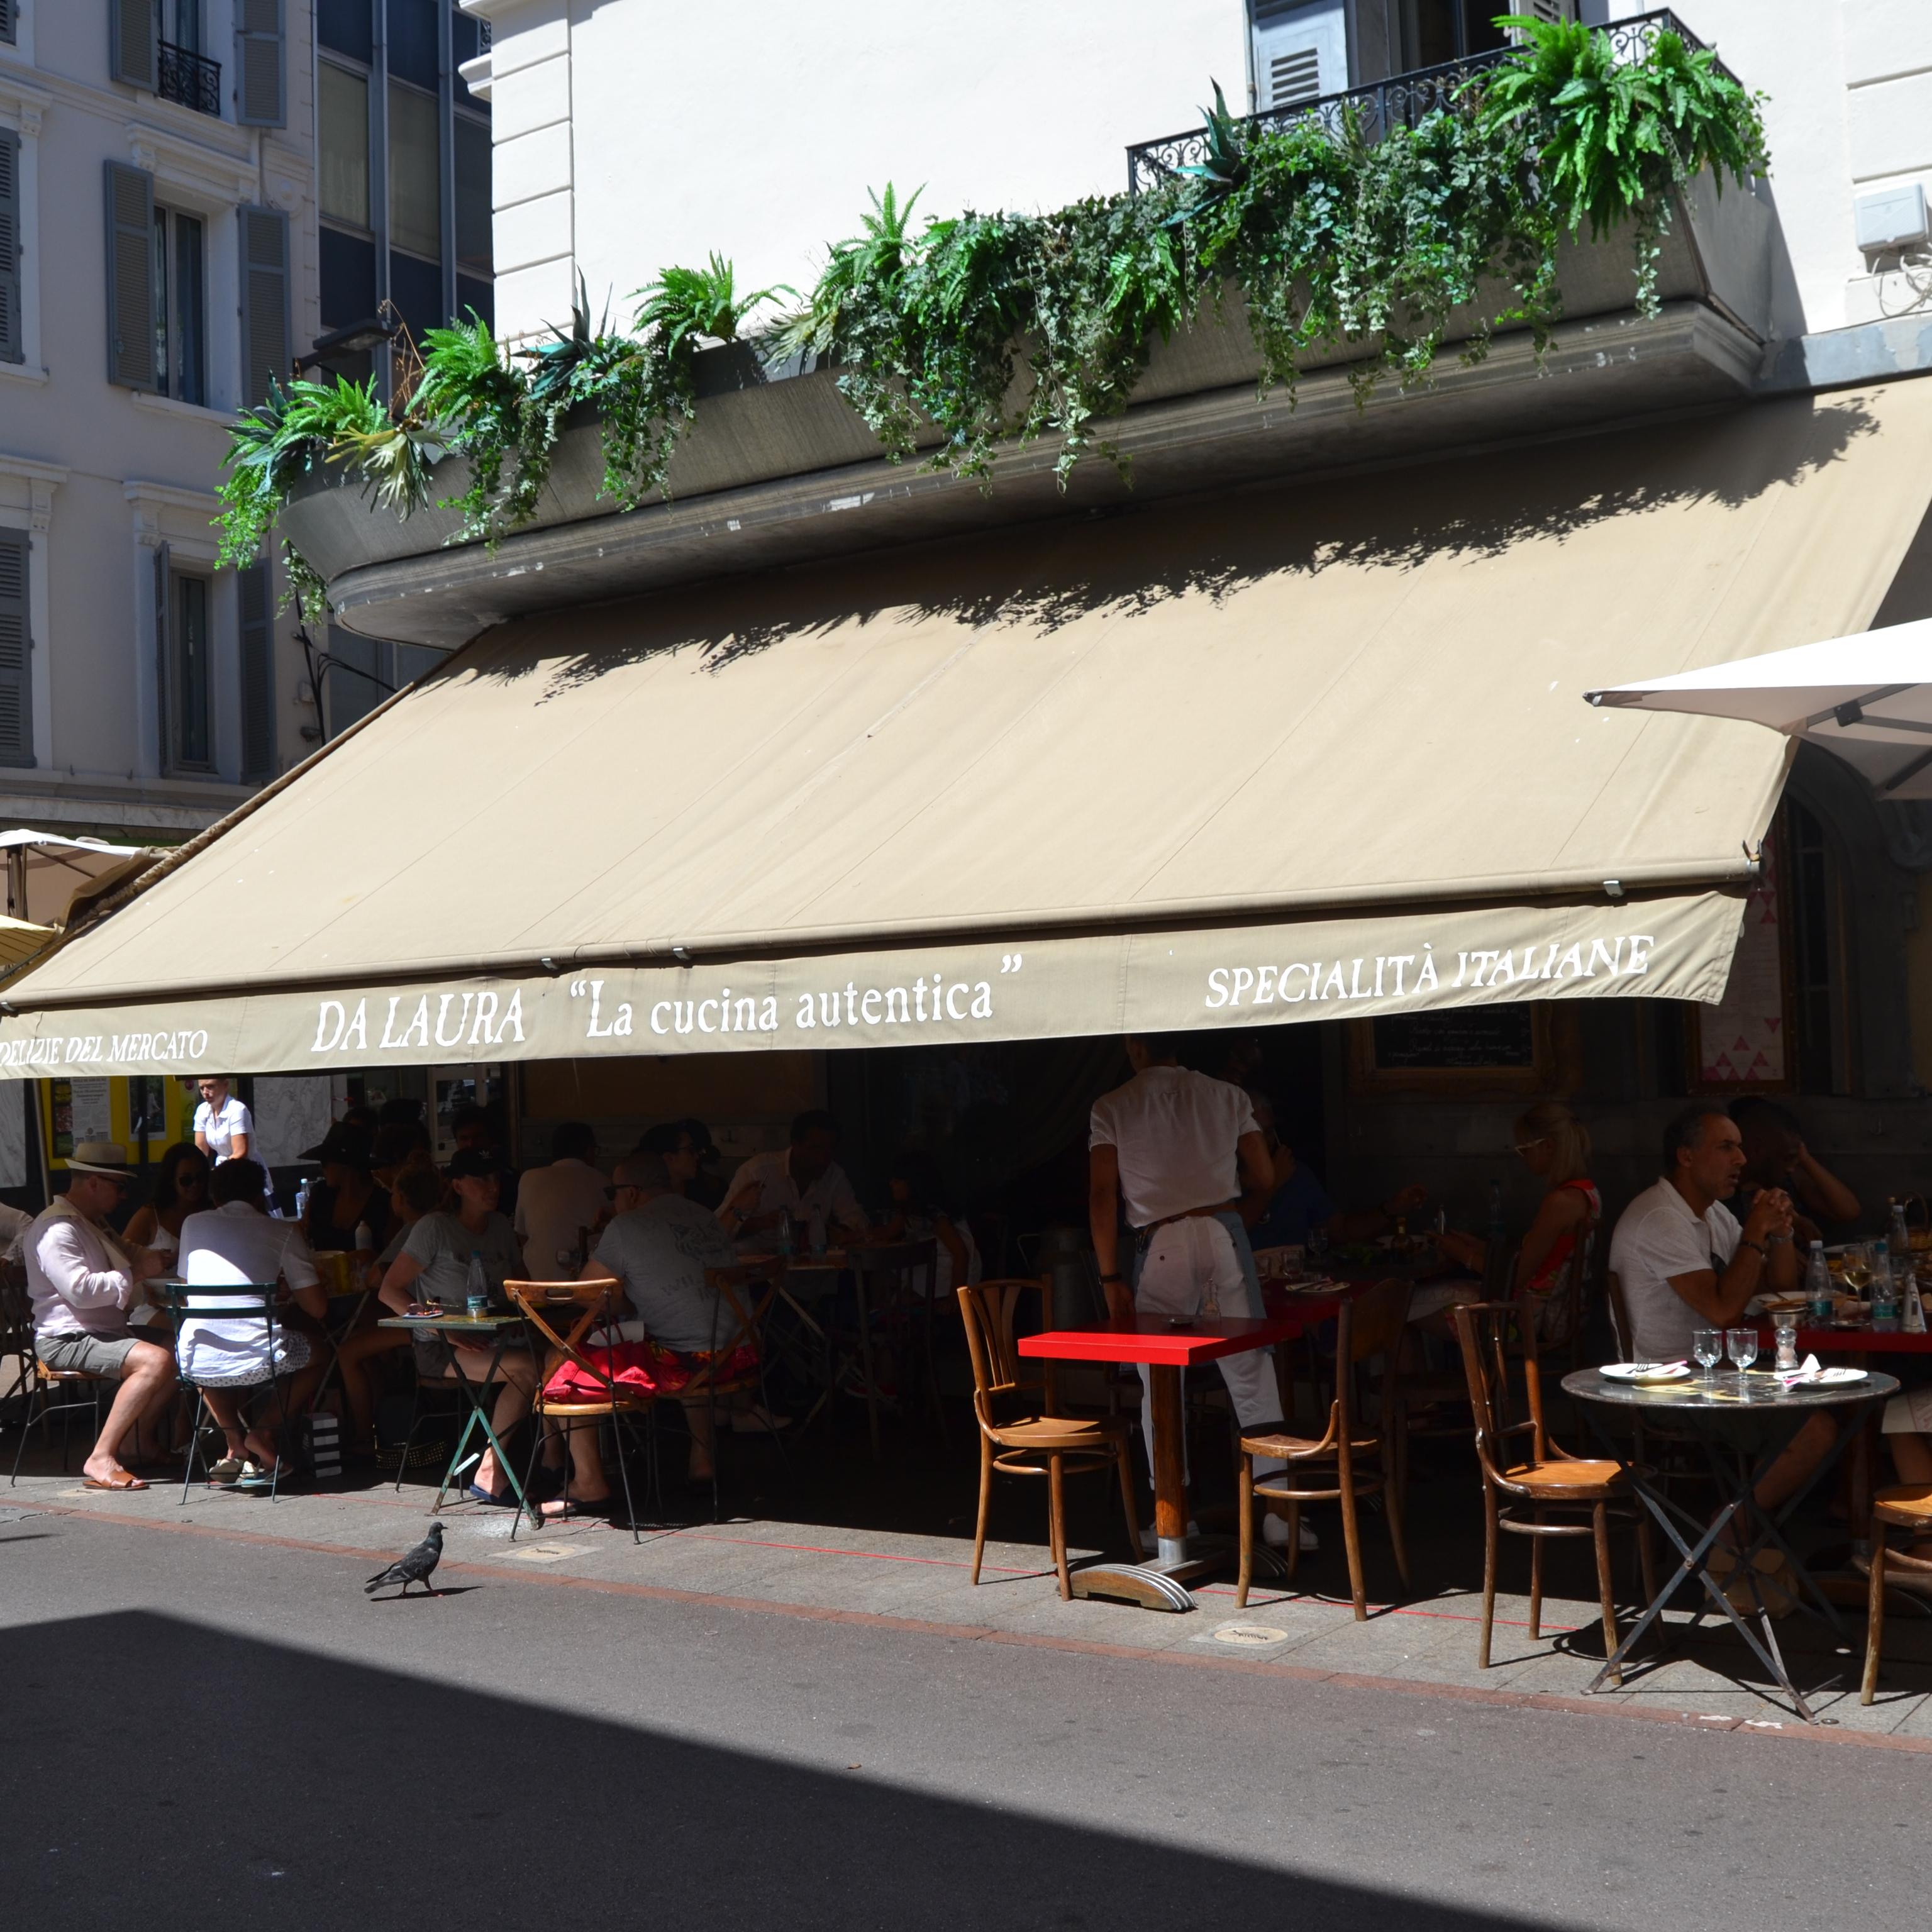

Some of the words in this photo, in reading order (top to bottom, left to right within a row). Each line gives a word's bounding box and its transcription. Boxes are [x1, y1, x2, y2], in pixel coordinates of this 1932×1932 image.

[1205, 942, 1440, 1008] SPECIALITÀ
[1451, 935, 1654, 987] ITALIANE
[311, 997, 367, 1052] DA
[379, 988, 525, 1048] LAURA
[651, 988, 779, 1034] cucina
[0, 1037, 64, 1067] DELIZIE
[65, 1036, 103, 1063] DEL
[106, 1030, 208, 1062] MERCATO
